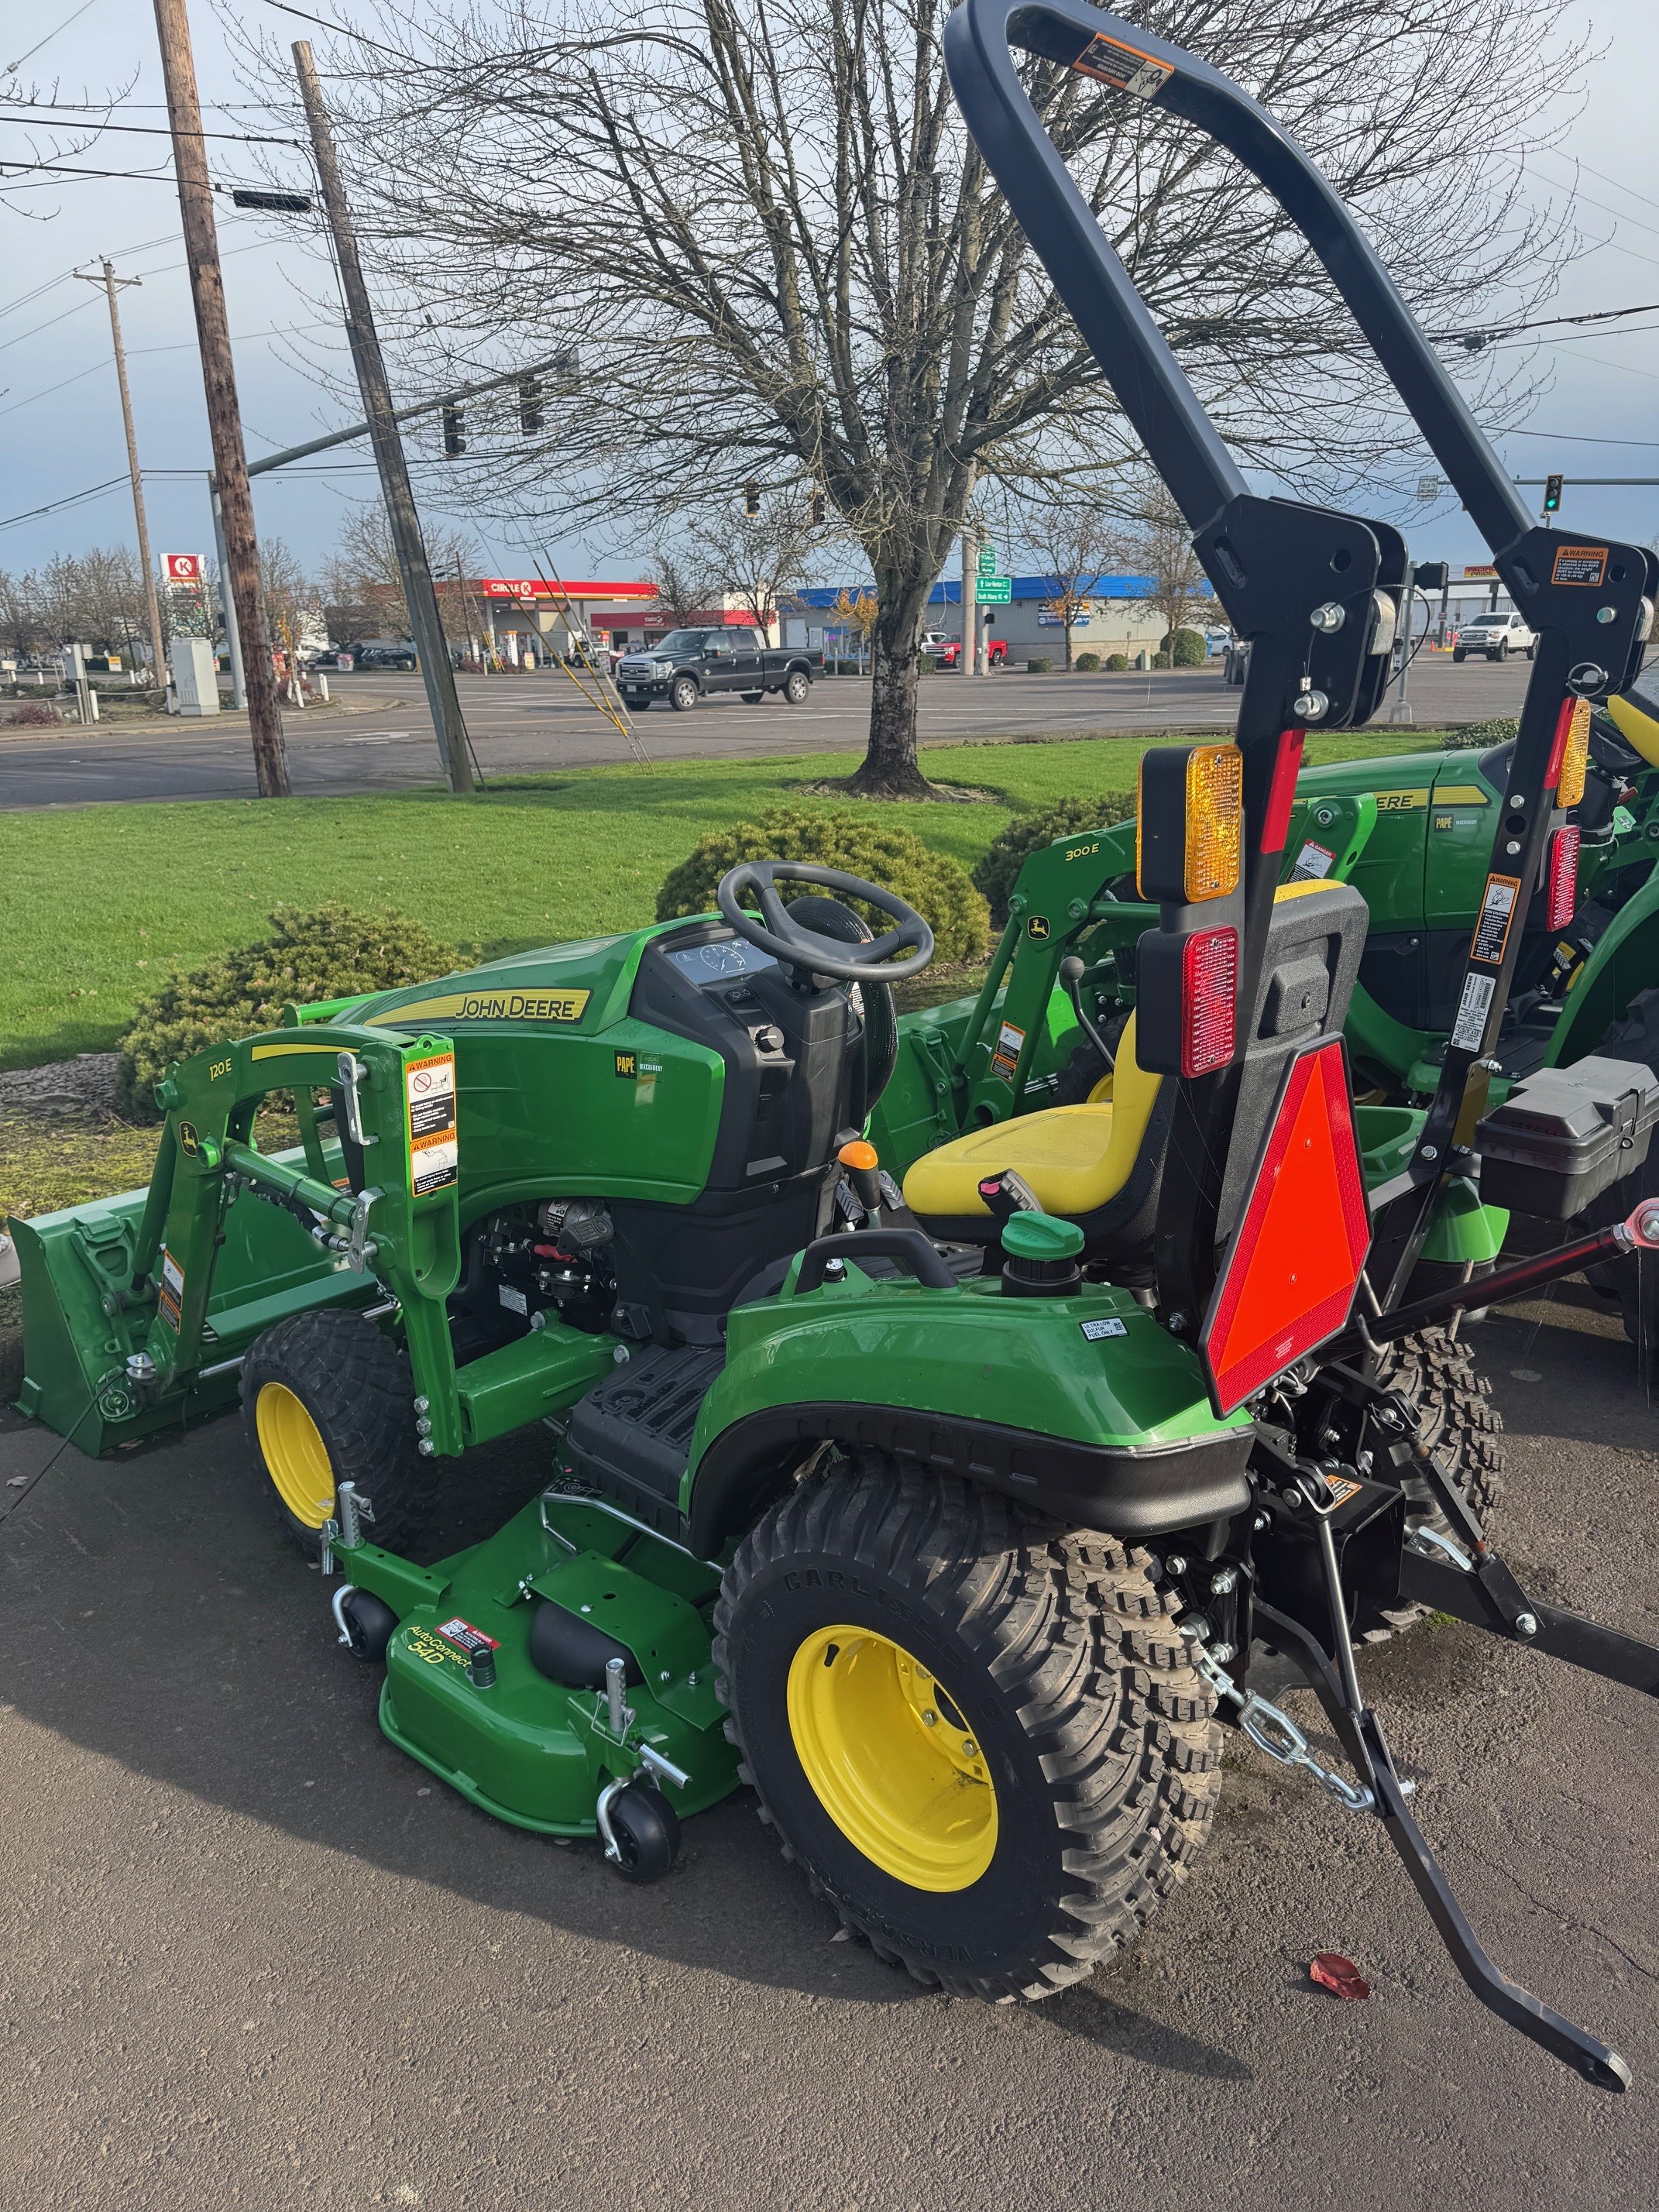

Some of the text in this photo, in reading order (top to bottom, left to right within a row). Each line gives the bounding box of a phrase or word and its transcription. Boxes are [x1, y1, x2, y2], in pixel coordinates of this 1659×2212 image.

[491, 583, 520, 592] CIRCLE
[1377, 795, 1413, 809] ERE
[1496, 877, 1518, 887] WARNING
[456, 996, 575, 1018] JOHN DEERE
[415, 1054, 452, 1070] WARNING
[639, 1063, 663, 1072] MACHINERY
[420, 1132, 455, 1149] WARNING
[477, 1632, 492, 1643] DANGER
[407, 1626, 472, 1668] AutoConnect
[408, 1641, 444, 1664] 54D
